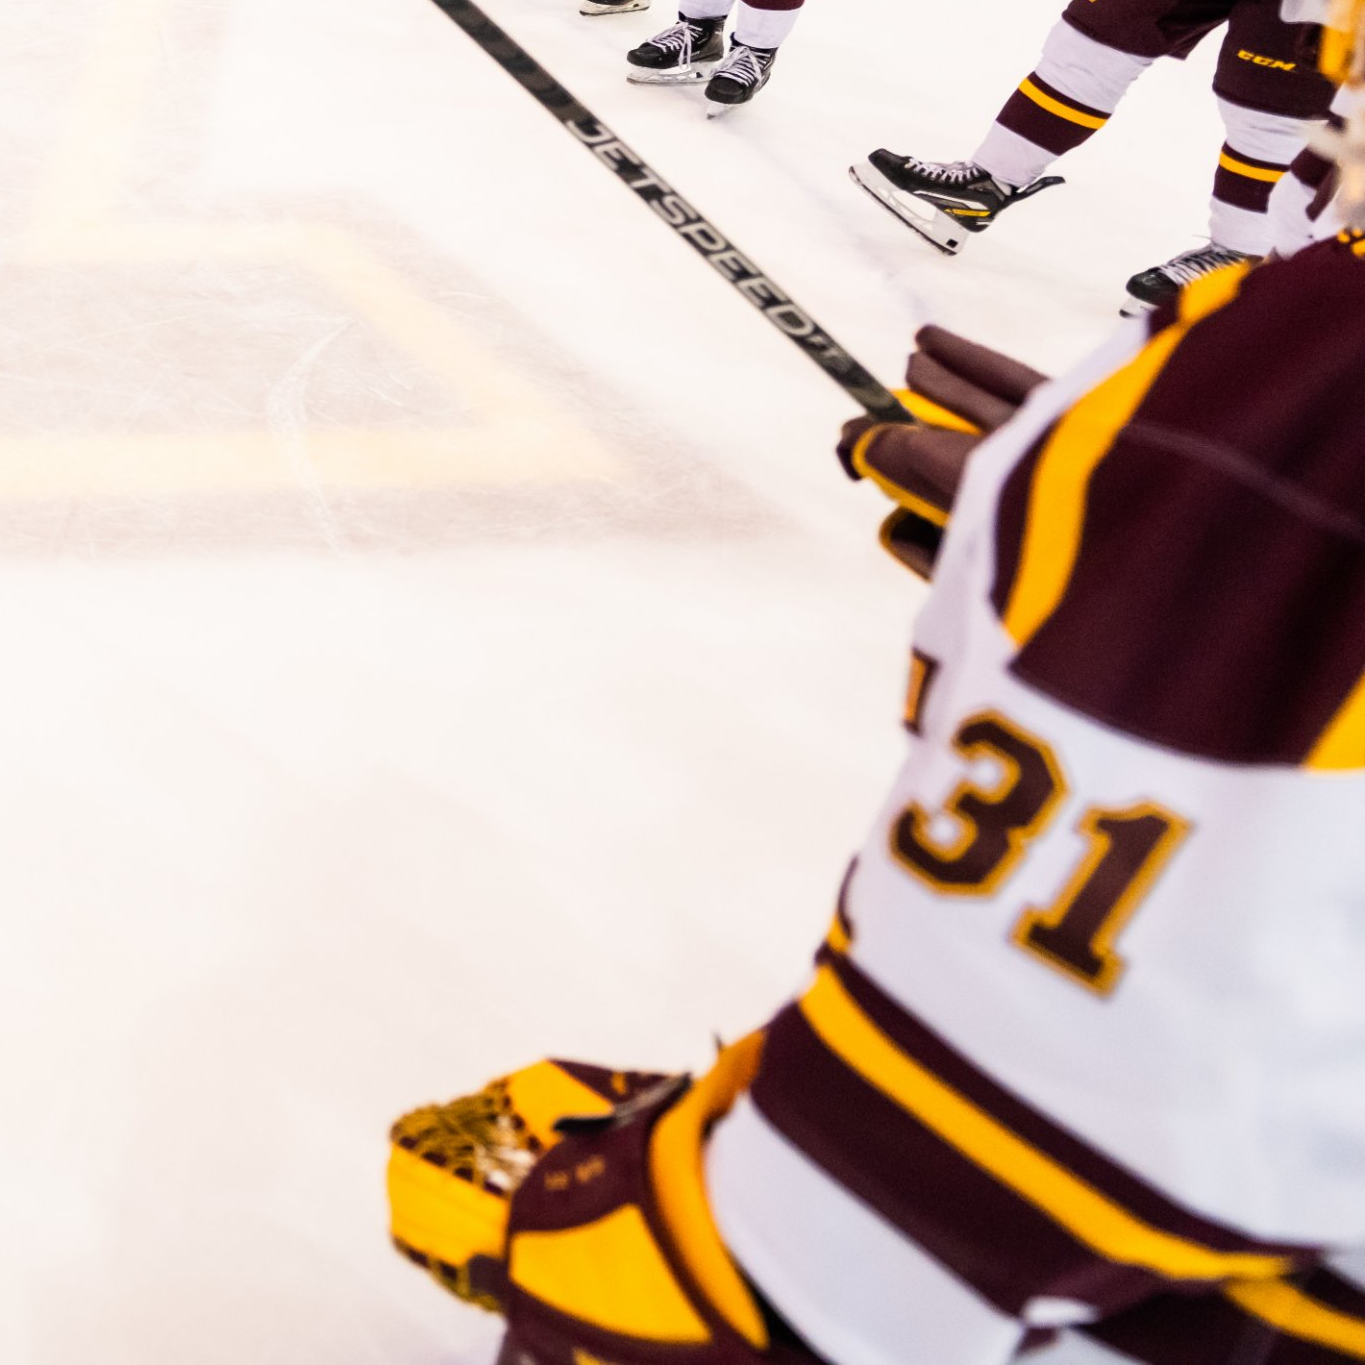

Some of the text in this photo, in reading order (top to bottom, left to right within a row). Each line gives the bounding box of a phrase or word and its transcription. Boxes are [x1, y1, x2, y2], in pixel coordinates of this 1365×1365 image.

[1236, 48, 1298, 72] CCM
[565, 117, 815, 337] JETSPEED
[887, 707, 1196, 1002] 31
